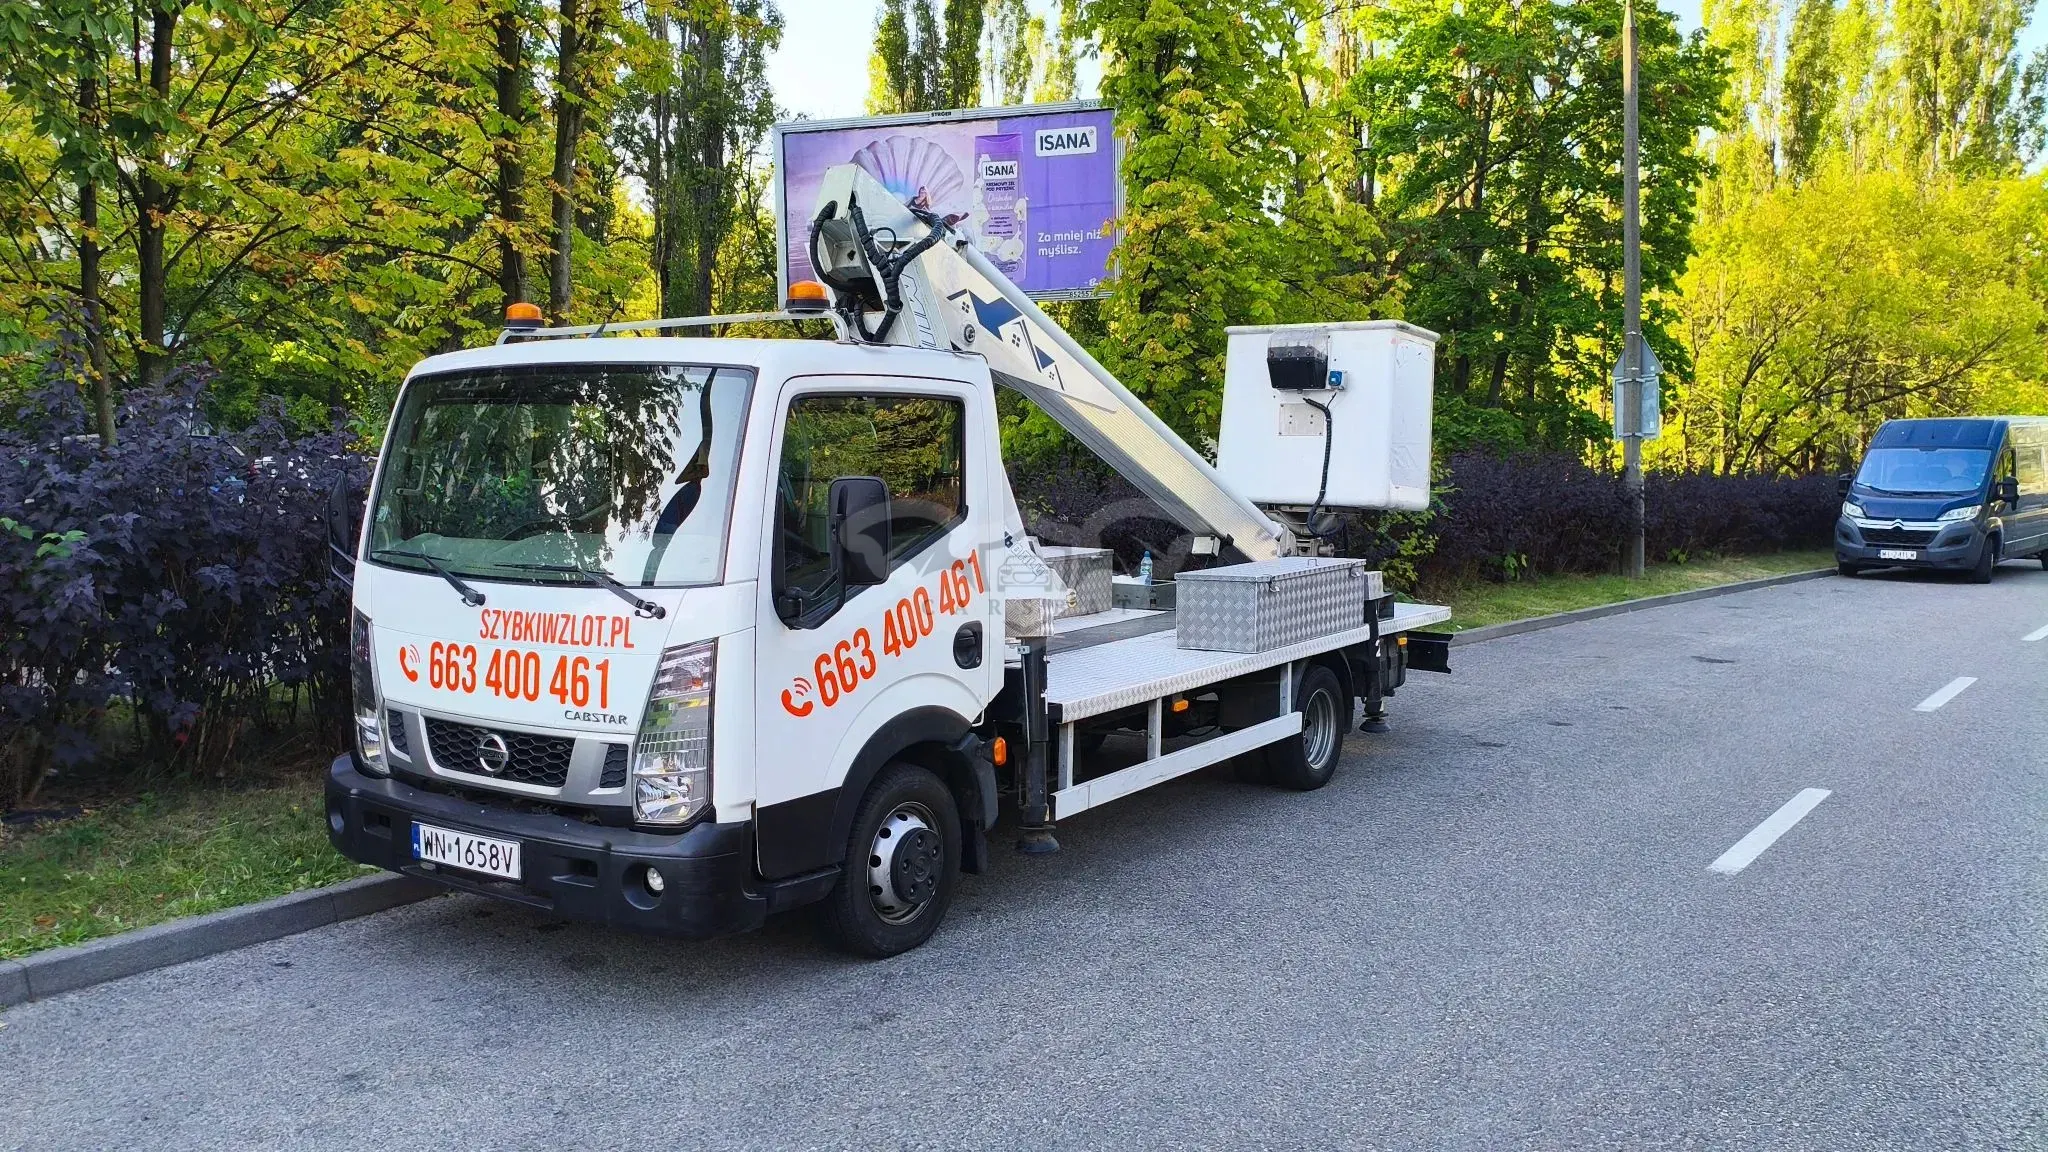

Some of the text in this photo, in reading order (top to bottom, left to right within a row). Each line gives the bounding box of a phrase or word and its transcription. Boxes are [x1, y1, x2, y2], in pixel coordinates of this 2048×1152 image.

[1040, 132, 1091, 151] ISANA
[985, 164, 1015, 176] ISANA
[1037, 232, 1051, 242] Za
[1054, 229, 1084, 242] mniej
[1038, 244, 1082, 258] myślisz.
[480, 608, 635, 648] SZYBKIWZLOT.PL
[814, 549, 985, 707] 663 400 461
[429, 641, 609, 709] 663 400 461
[564, 709, 628, 725] CABSTAR
[423, 829, 446, 860] WN
[454, 836, 513, 874] 1658V
